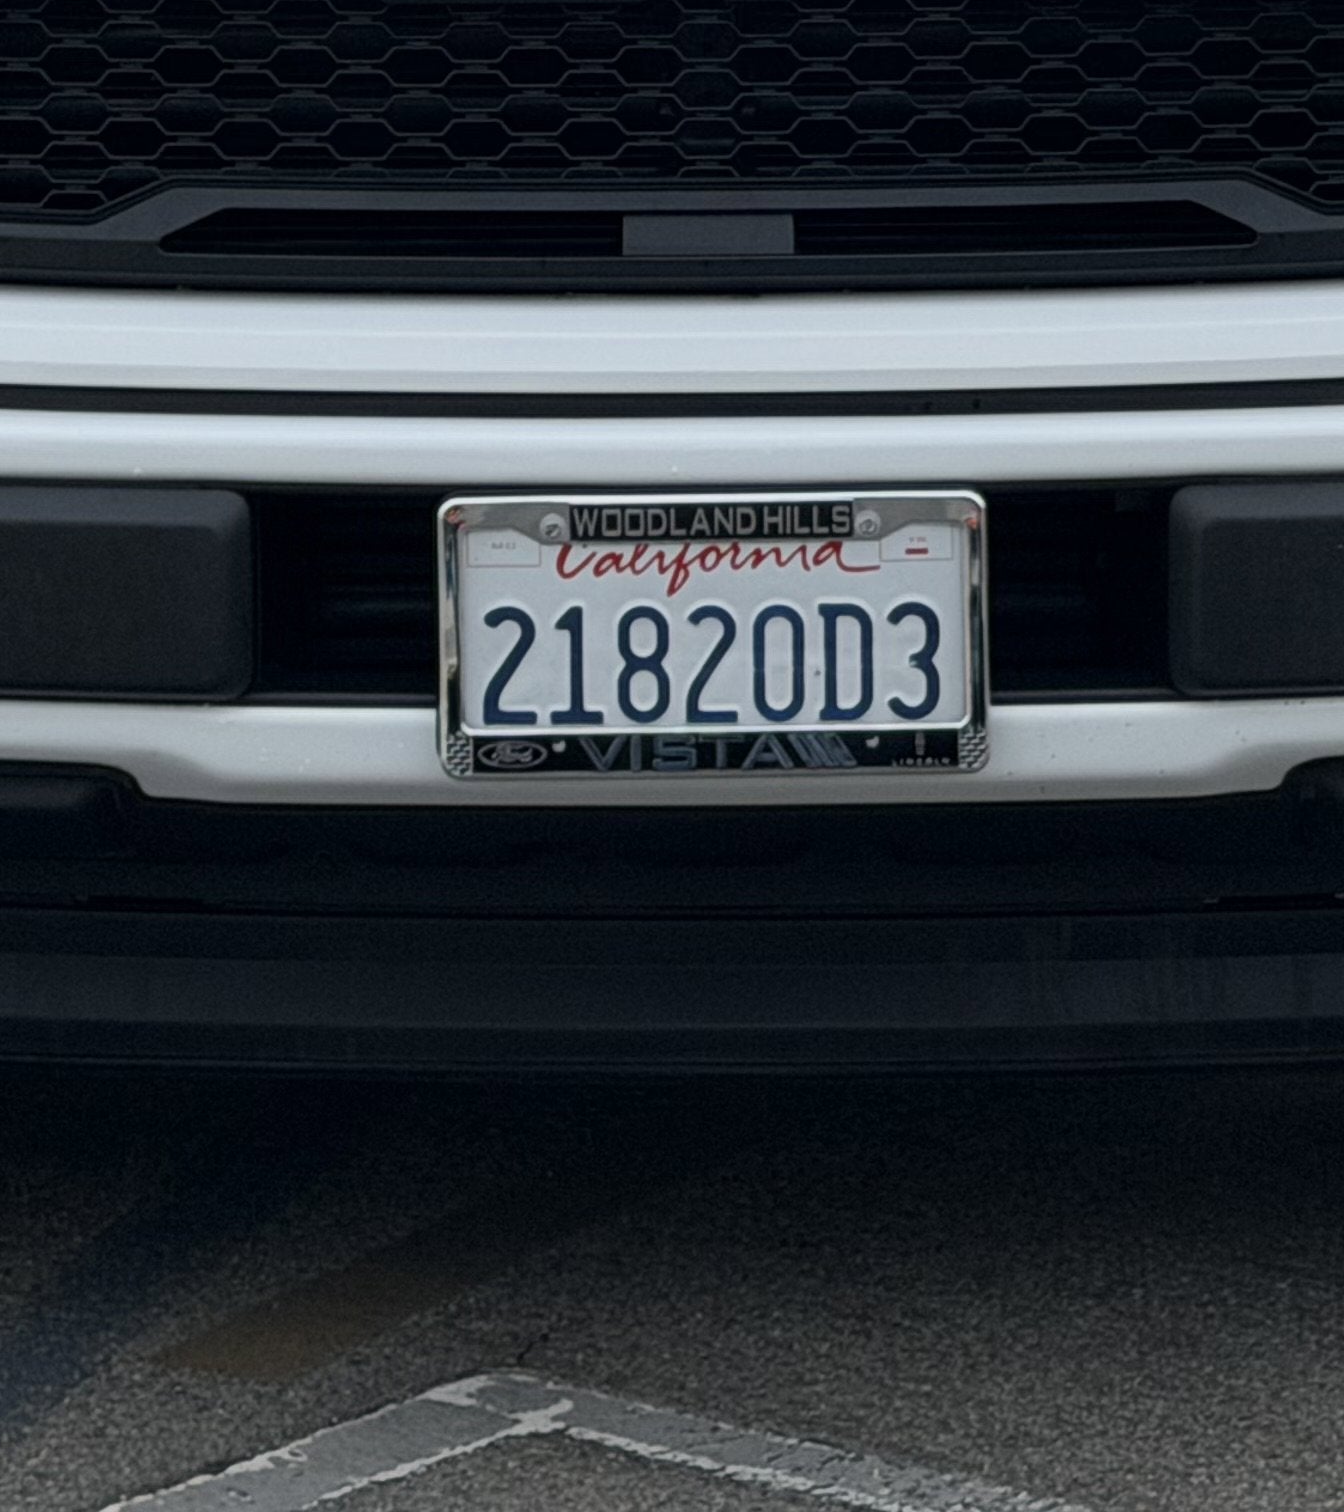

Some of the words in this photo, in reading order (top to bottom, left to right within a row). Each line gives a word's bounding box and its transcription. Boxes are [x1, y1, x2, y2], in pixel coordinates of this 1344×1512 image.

[572, 505, 755, 537] WOODLAND
[762, 504, 852, 535] HILLS
[555, 539, 881, 598] California
[482, 600, 942, 726] 21820D3
[577, 731, 794, 772] VISTA
